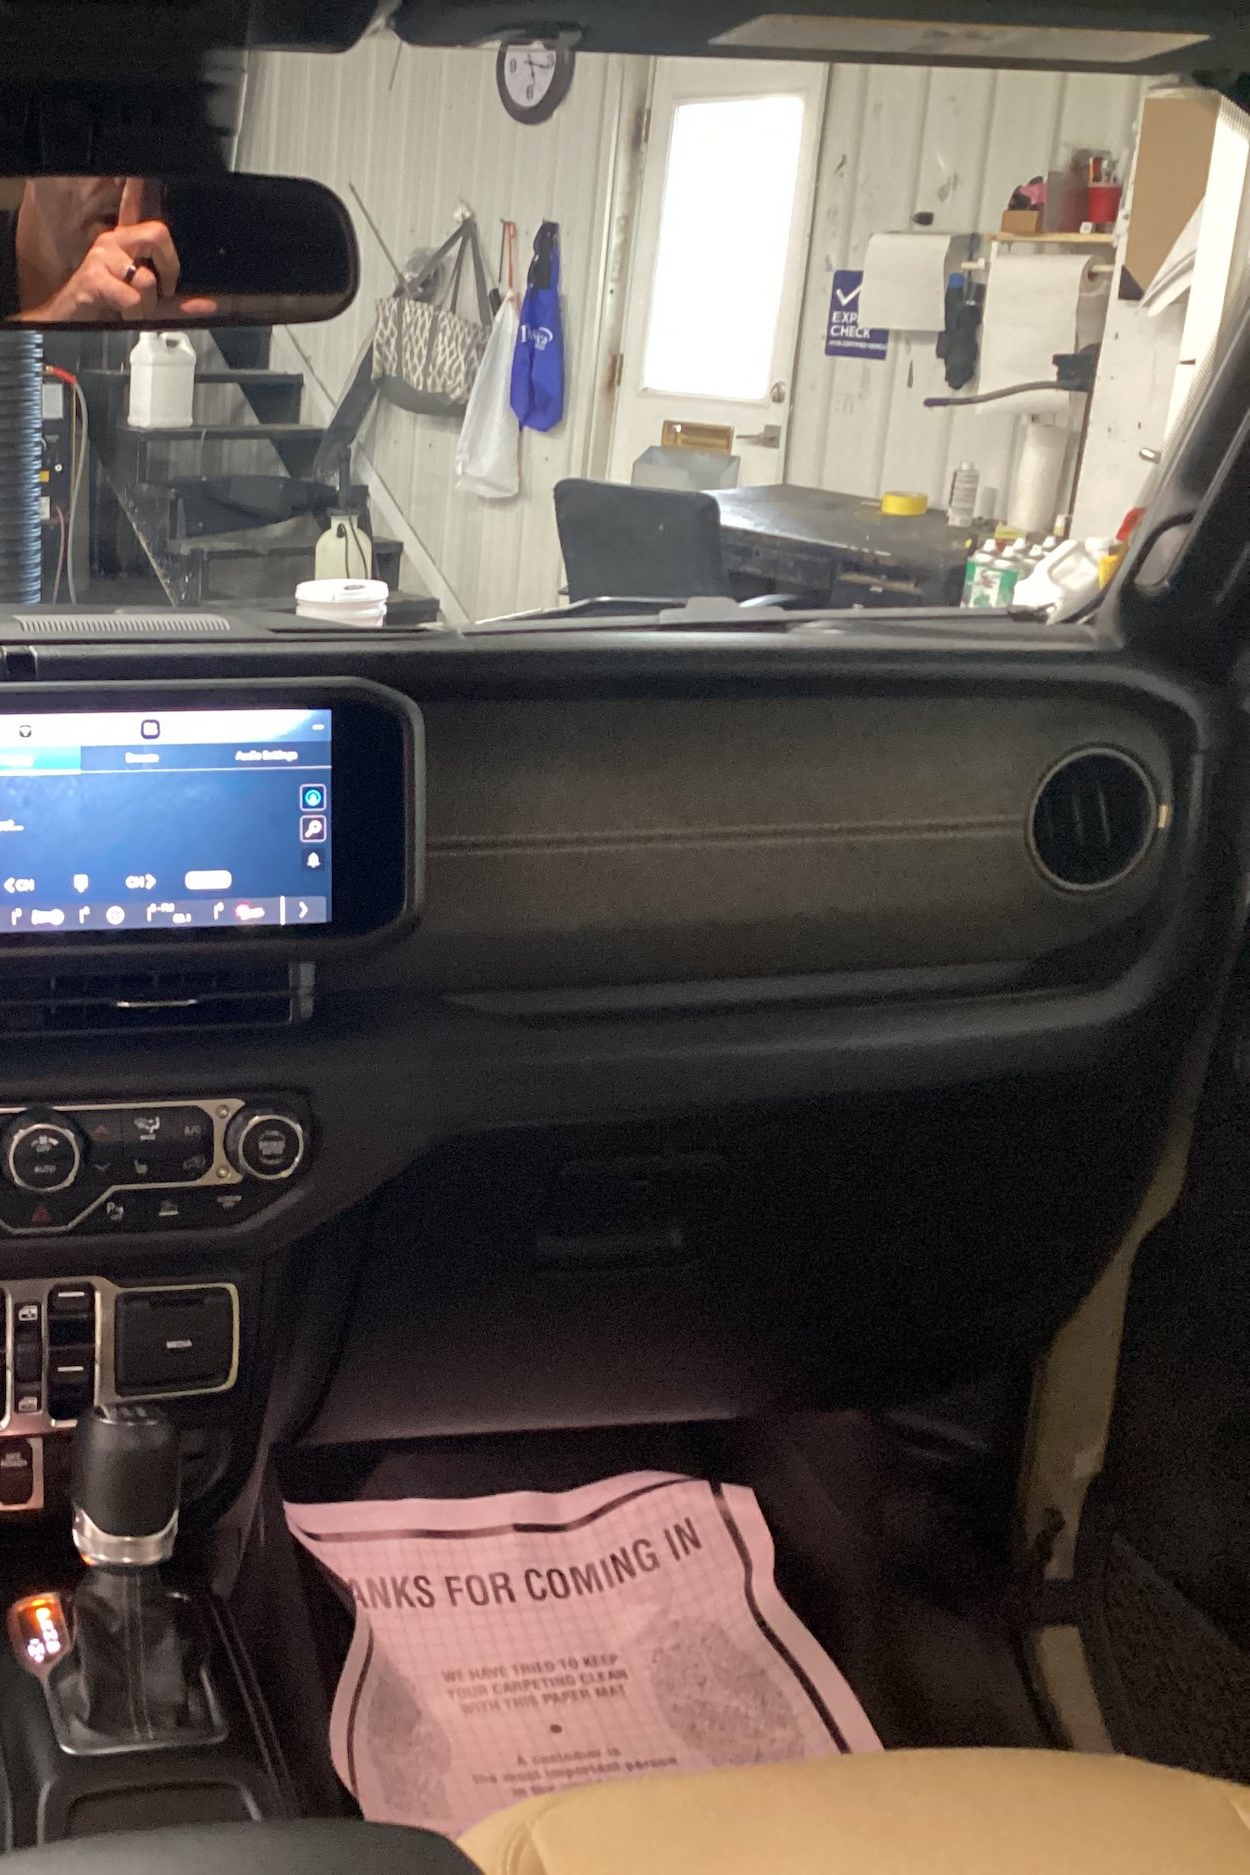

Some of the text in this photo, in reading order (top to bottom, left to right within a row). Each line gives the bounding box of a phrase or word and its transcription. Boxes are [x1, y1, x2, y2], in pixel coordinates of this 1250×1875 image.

[830, 325, 870, 339] CHECK
[444, 1571, 517, 1607] FOR
[524, 1538, 661, 1601] COMING
[663, 1517, 702, 1562] IN
[558, 1656, 580, 1671] TO
[582, 1653, 619, 1668] KEEP
